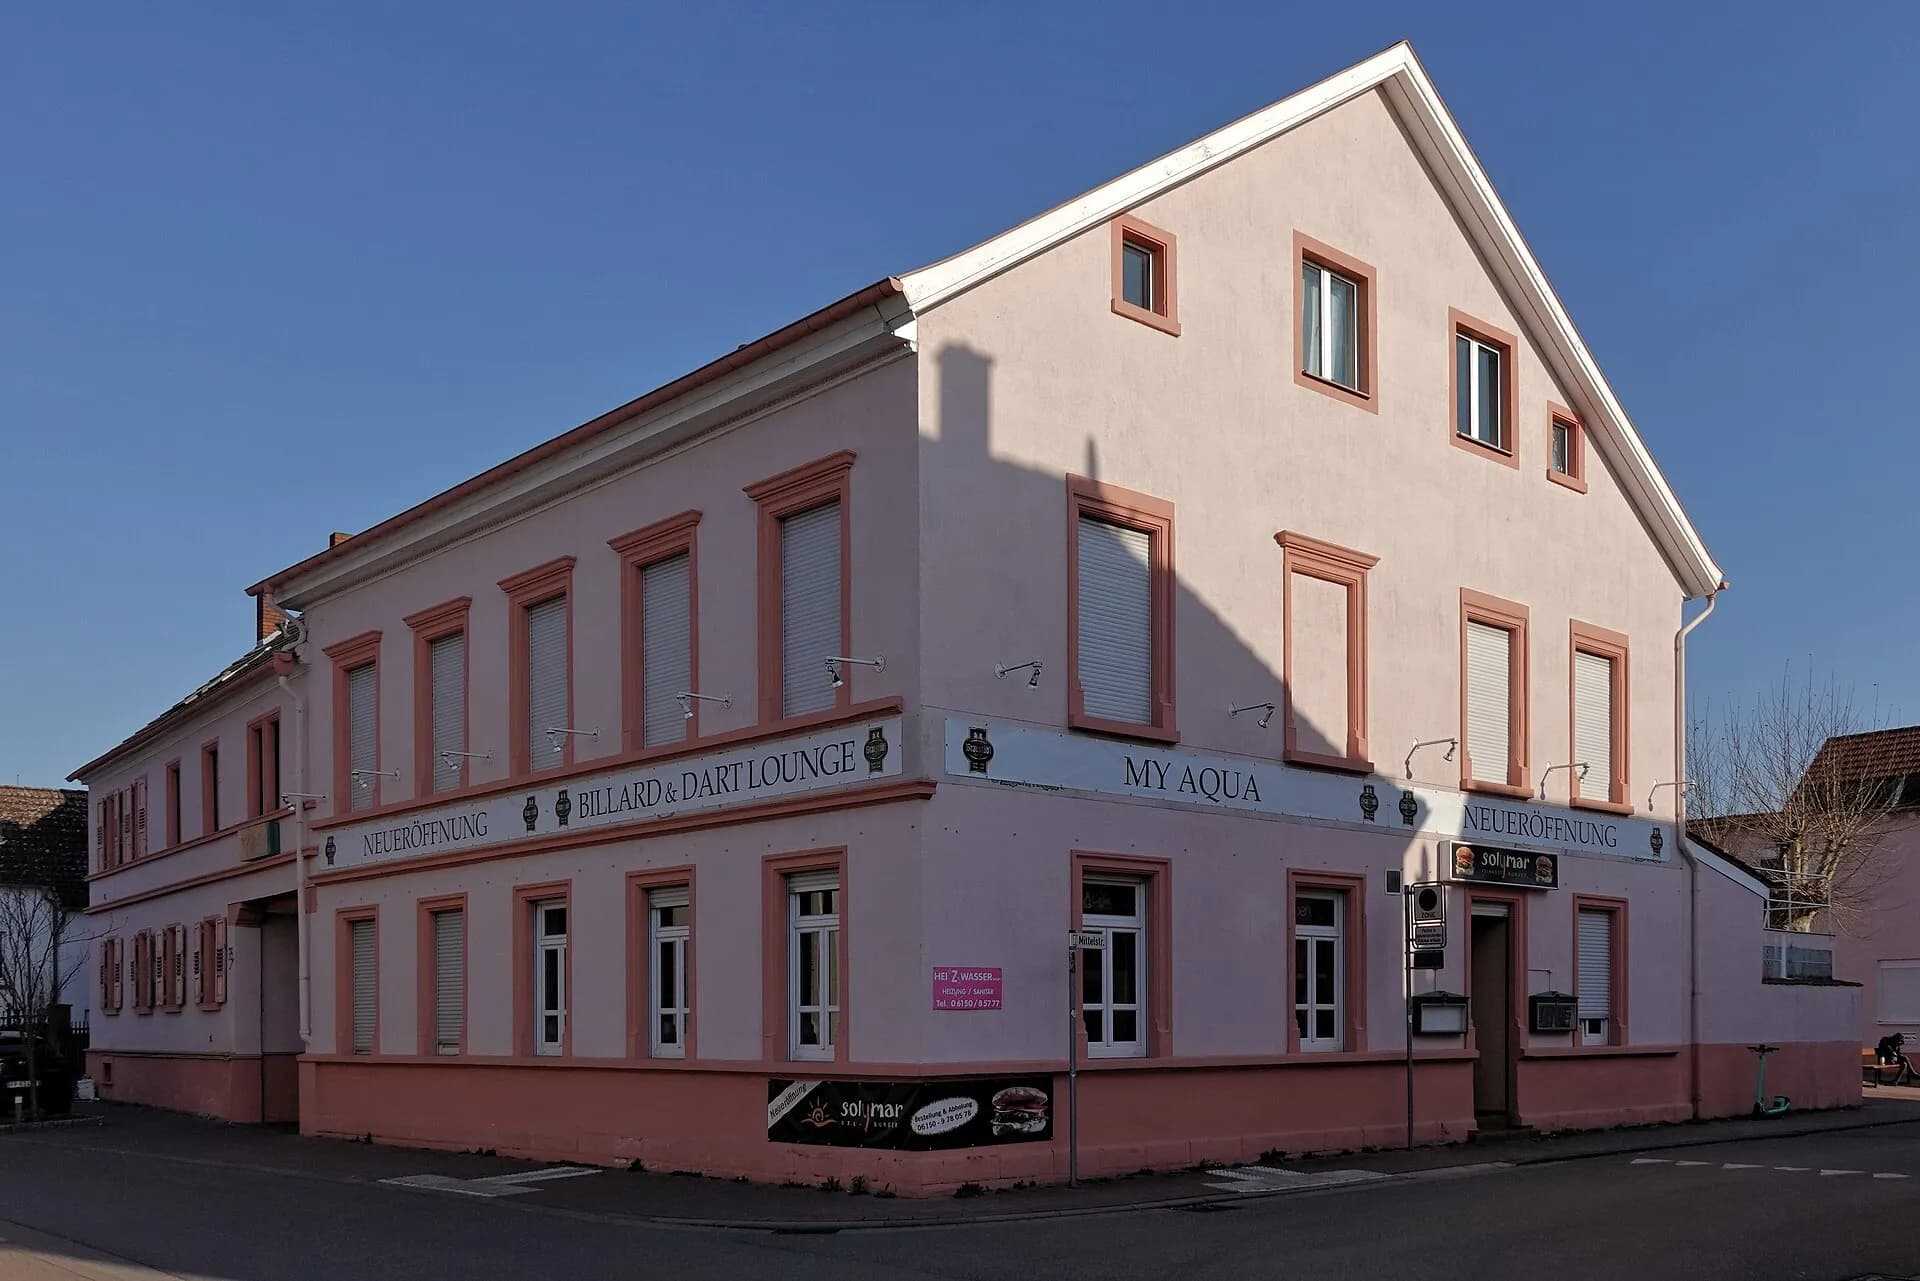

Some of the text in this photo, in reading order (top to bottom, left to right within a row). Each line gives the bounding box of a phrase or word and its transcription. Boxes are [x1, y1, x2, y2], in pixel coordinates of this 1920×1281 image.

[578, 740, 856, 818] BILLARD & DART LOUNGE
[1123, 756, 1261, 803] MY AQUA
[363, 811, 488, 857] NEUERÖFFNUNG
[1463, 804, 1617, 848] NEUERÖFFNUNG
[1481, 851, 1531, 879] solymar
[1078, 935, 1105, 947] Mittelstr.
[960, 972, 993, 981] WASSER
[840, 1100, 904, 1133] solymar
[914, 1111, 942, 1122] Bestellung
[948, 1101, 973, 1113] Abholung
